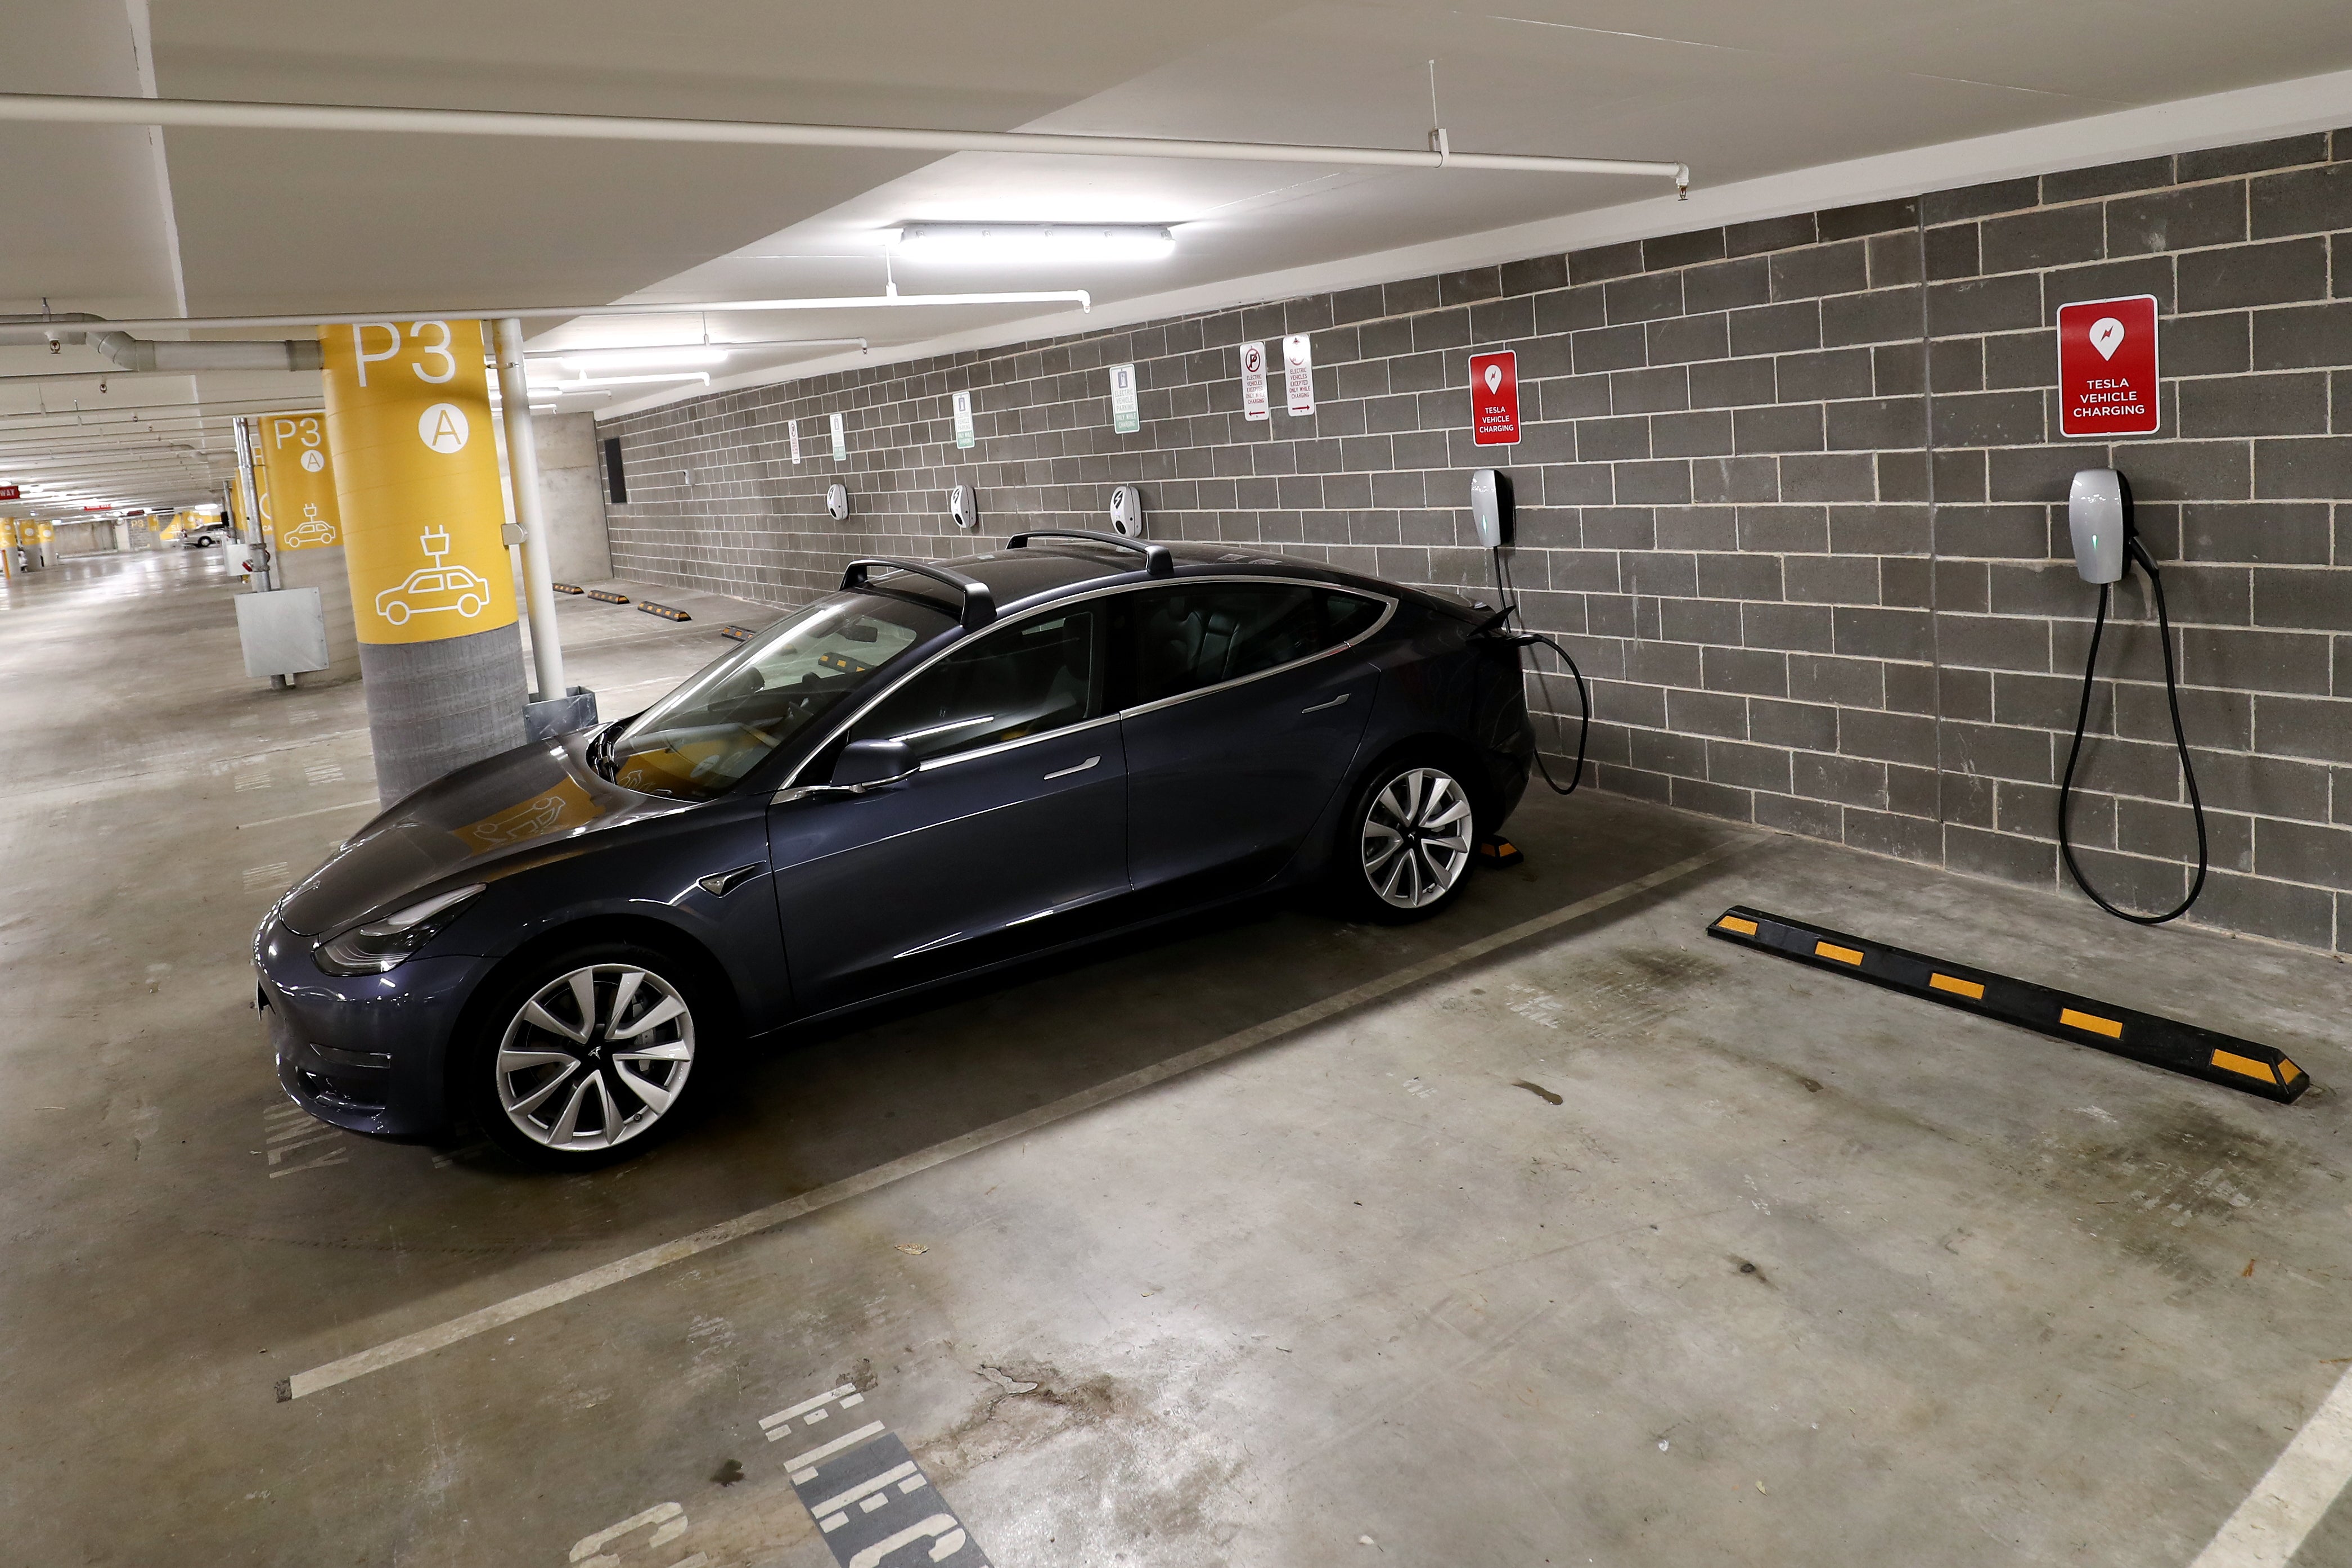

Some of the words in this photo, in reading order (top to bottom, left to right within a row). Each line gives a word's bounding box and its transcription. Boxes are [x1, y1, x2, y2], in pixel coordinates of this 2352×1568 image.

[353, 320, 456, 388] P3
[2086, 378, 2129, 390] TESLA
[1114, 388, 1134, 397] ELECTRIC
[2080, 391, 2137, 404] VEHICLE
[1116, 396, 1133, 404] VEHICLE
[2073, 404, 2145, 417] CHARGING
[1482, 415, 1510, 423] VEHICLE
[274, 417, 321, 449] P3
[431, 409, 462, 446] A
[1479, 424, 1514, 433] CHARGING
[306, 452, 321, 469] A
[758, 1382, 966, 1568] ELEC
